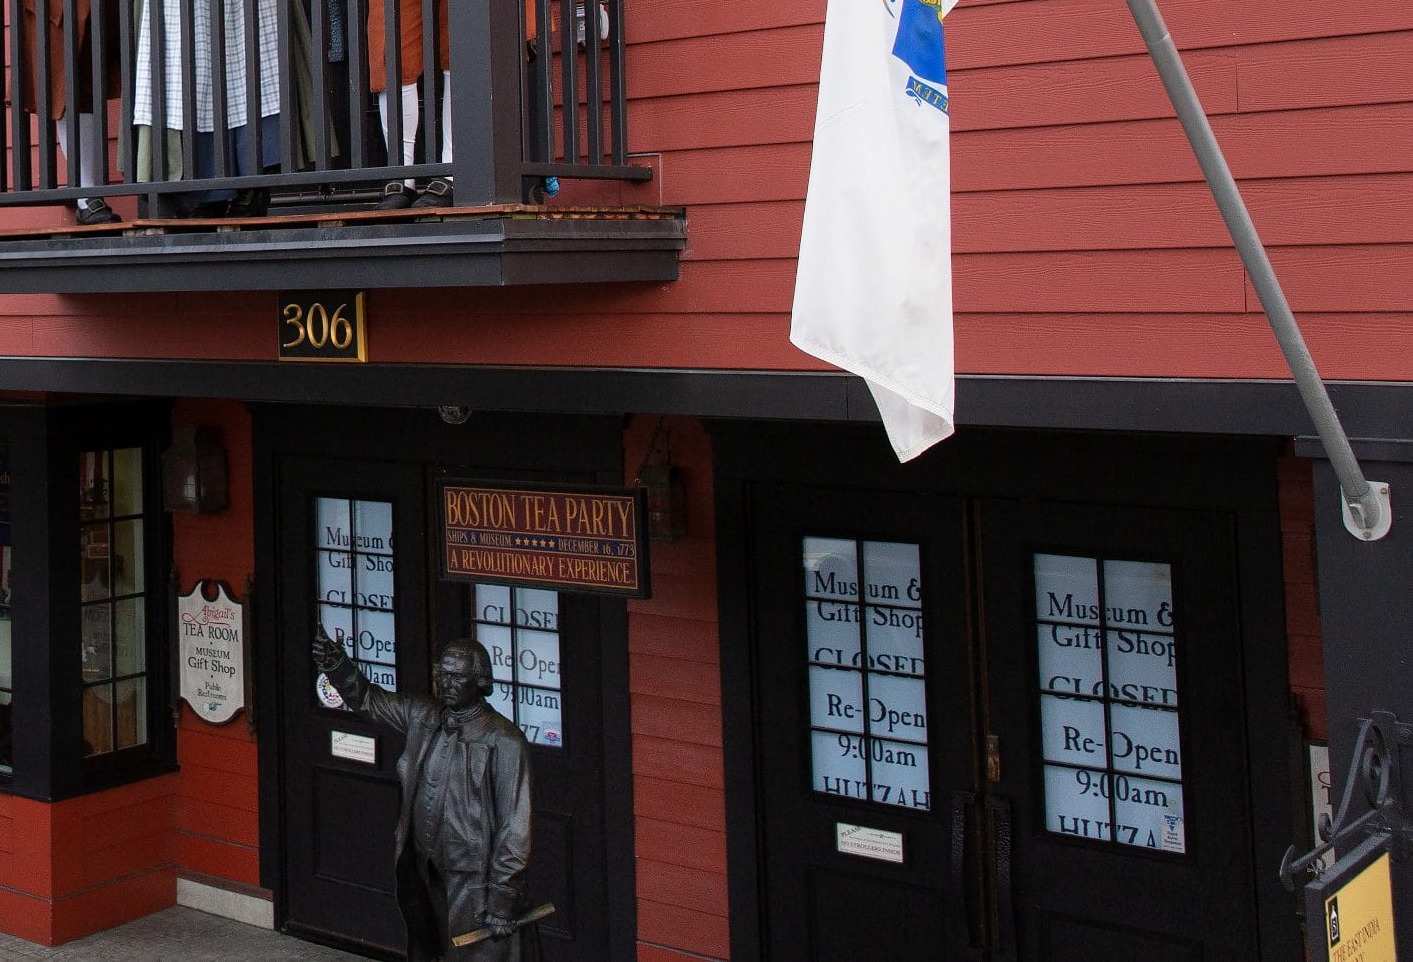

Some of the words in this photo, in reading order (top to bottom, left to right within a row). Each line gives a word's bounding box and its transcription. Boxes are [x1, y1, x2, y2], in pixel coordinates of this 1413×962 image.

[283, 303, 353, 349] 306
[447, 491, 516, 529] BOSTON
[521, 495, 560, 533] TEA
[565, 498, 632, 537] PARTY
[325, 526, 384, 549] Mueum
[447, 532, 468, 544] SHIPS
[471, 534, 476, 543] &
[479, 534, 511, 547] MUSEUM
[558, 540, 599, 554] DECEMBER
[617, 544, 635, 557] 1773
[366, 555, 394, 572] Sho
[450, 549, 458, 568] A
[462, 550, 555, 576] REVOLUTIONARY
[558, 557, 632, 584] EXPERIENCE
[814, 571, 900, 600] Musum
[199, 605, 235, 621] Abigail's
[1047, 592, 1148, 626] Musum
[1157, 602, 1174, 627] &
[183, 622, 204, 637] TEA
[208, 626, 239, 642] ROOM
[196, 647, 230, 659] MUSEUM
[188, 657, 208, 670] Gift
[211, 660, 236, 678] Shop
